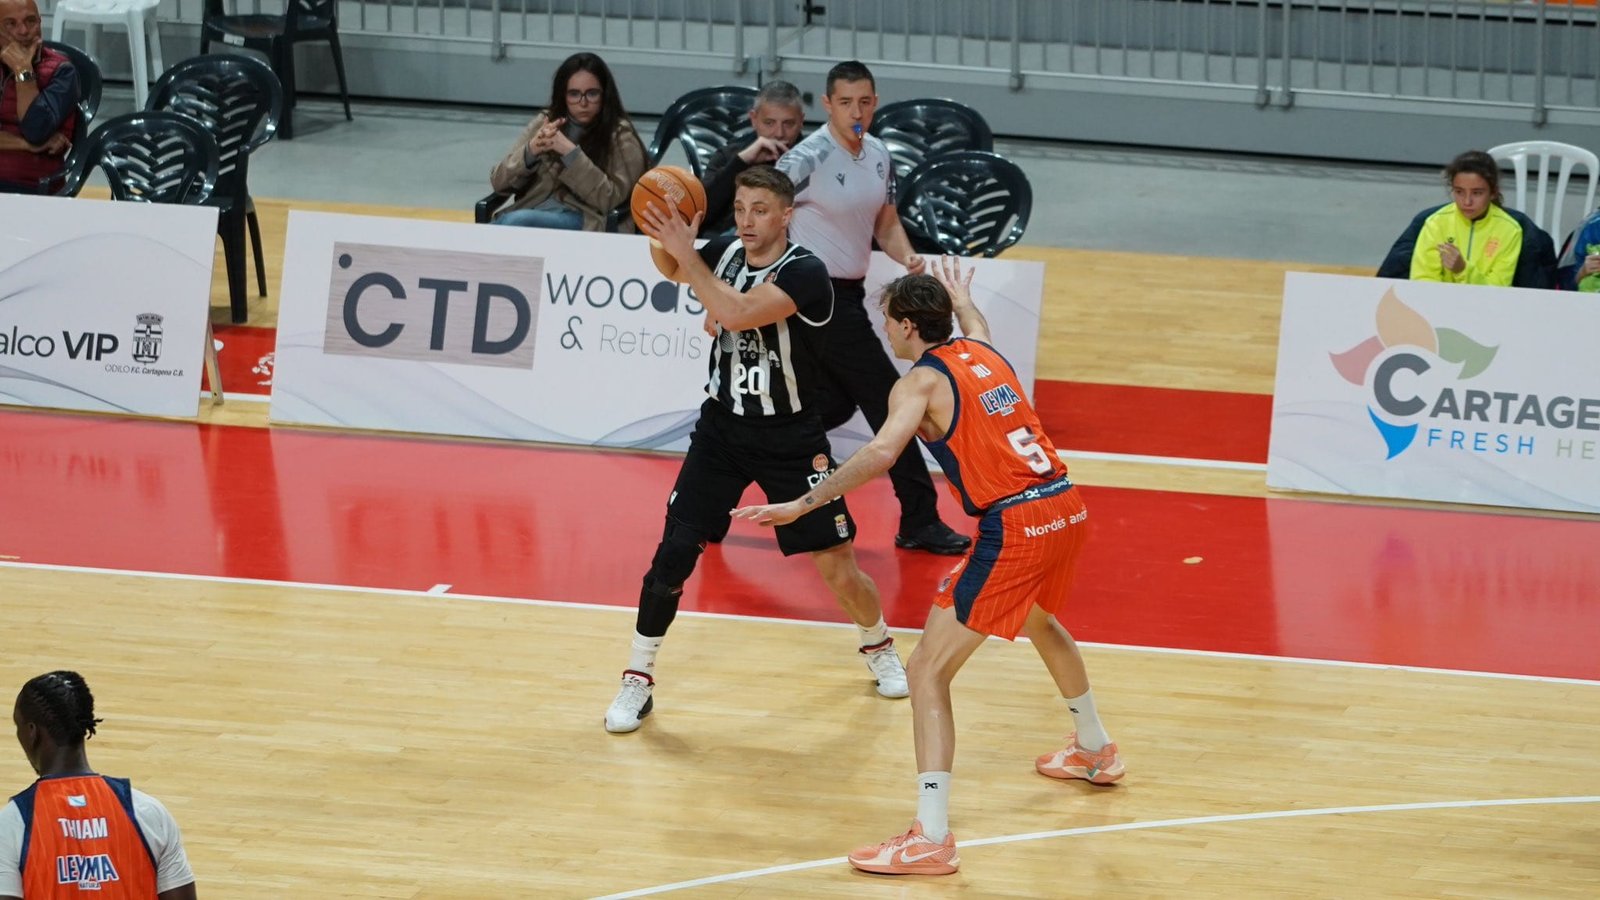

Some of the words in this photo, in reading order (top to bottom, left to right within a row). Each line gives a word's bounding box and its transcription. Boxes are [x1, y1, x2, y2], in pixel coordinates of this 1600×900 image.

[343, 272, 531, 354] CTD
[63, 331, 119, 361] VIP
[560, 316, 583, 350] &
[600, 324, 701, 359] Retails
[734, 363, 766, 395] 20
[979, 384, 1020, 413] LEYMA
[1006, 426, 1053, 474] 5
[1428, 429, 1534, 455] FRESH
[1556, 438, 1596, 459] HE
[1024, 516, 1066, 538] Nordés
[58, 818, 108, 839] THIAM
[57, 855, 118, 882] LEYMA
